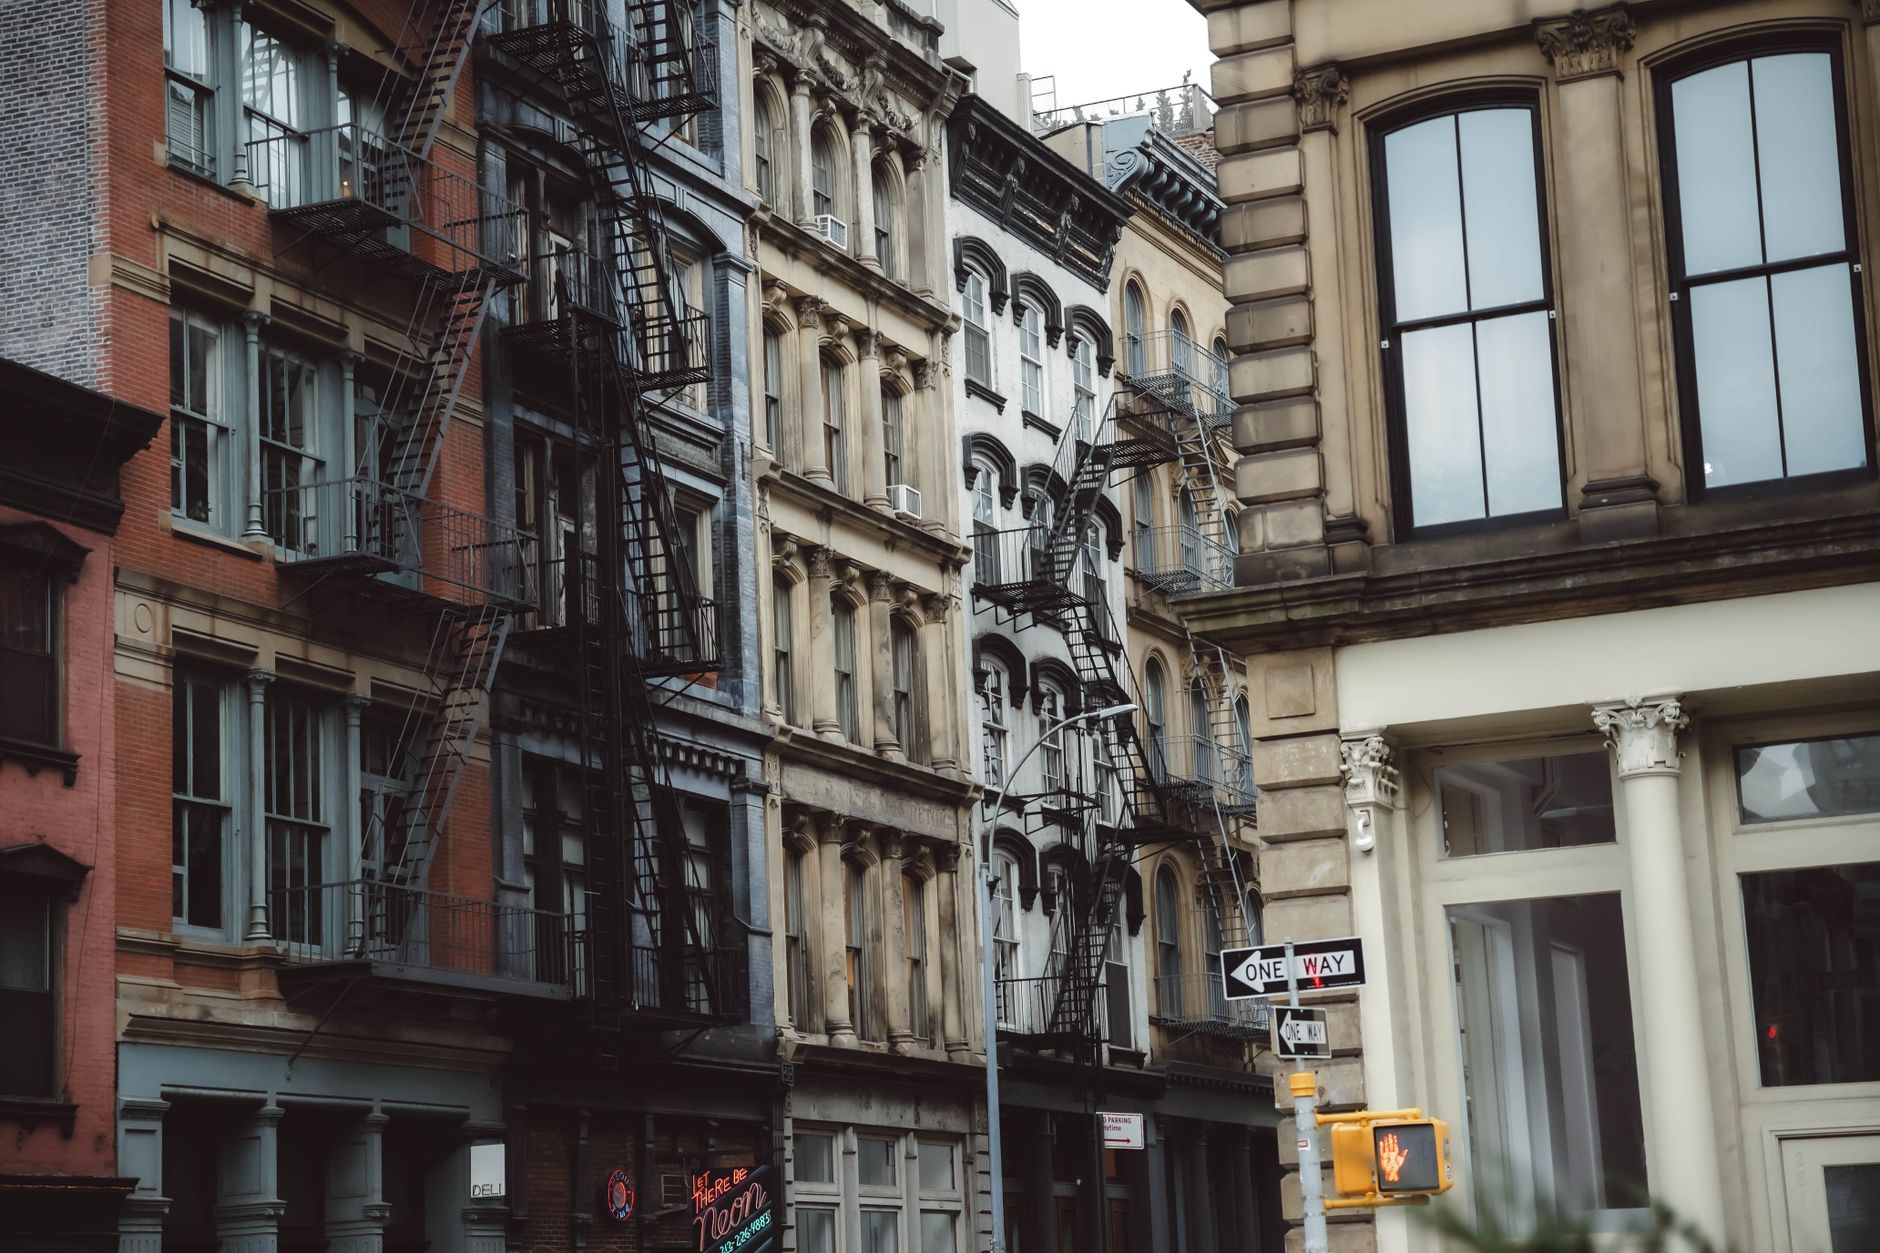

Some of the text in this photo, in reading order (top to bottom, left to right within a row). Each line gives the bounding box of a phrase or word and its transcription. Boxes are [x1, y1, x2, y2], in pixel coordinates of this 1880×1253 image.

[1245, 954, 1344, 982] ONE WAY
[1285, 1022, 1322, 1041] ONE WAY
[472, 1183, 502, 1197] DELI
[691, 1167, 748, 1215] THERE BE
[692, 1170, 711, 1196] LET
